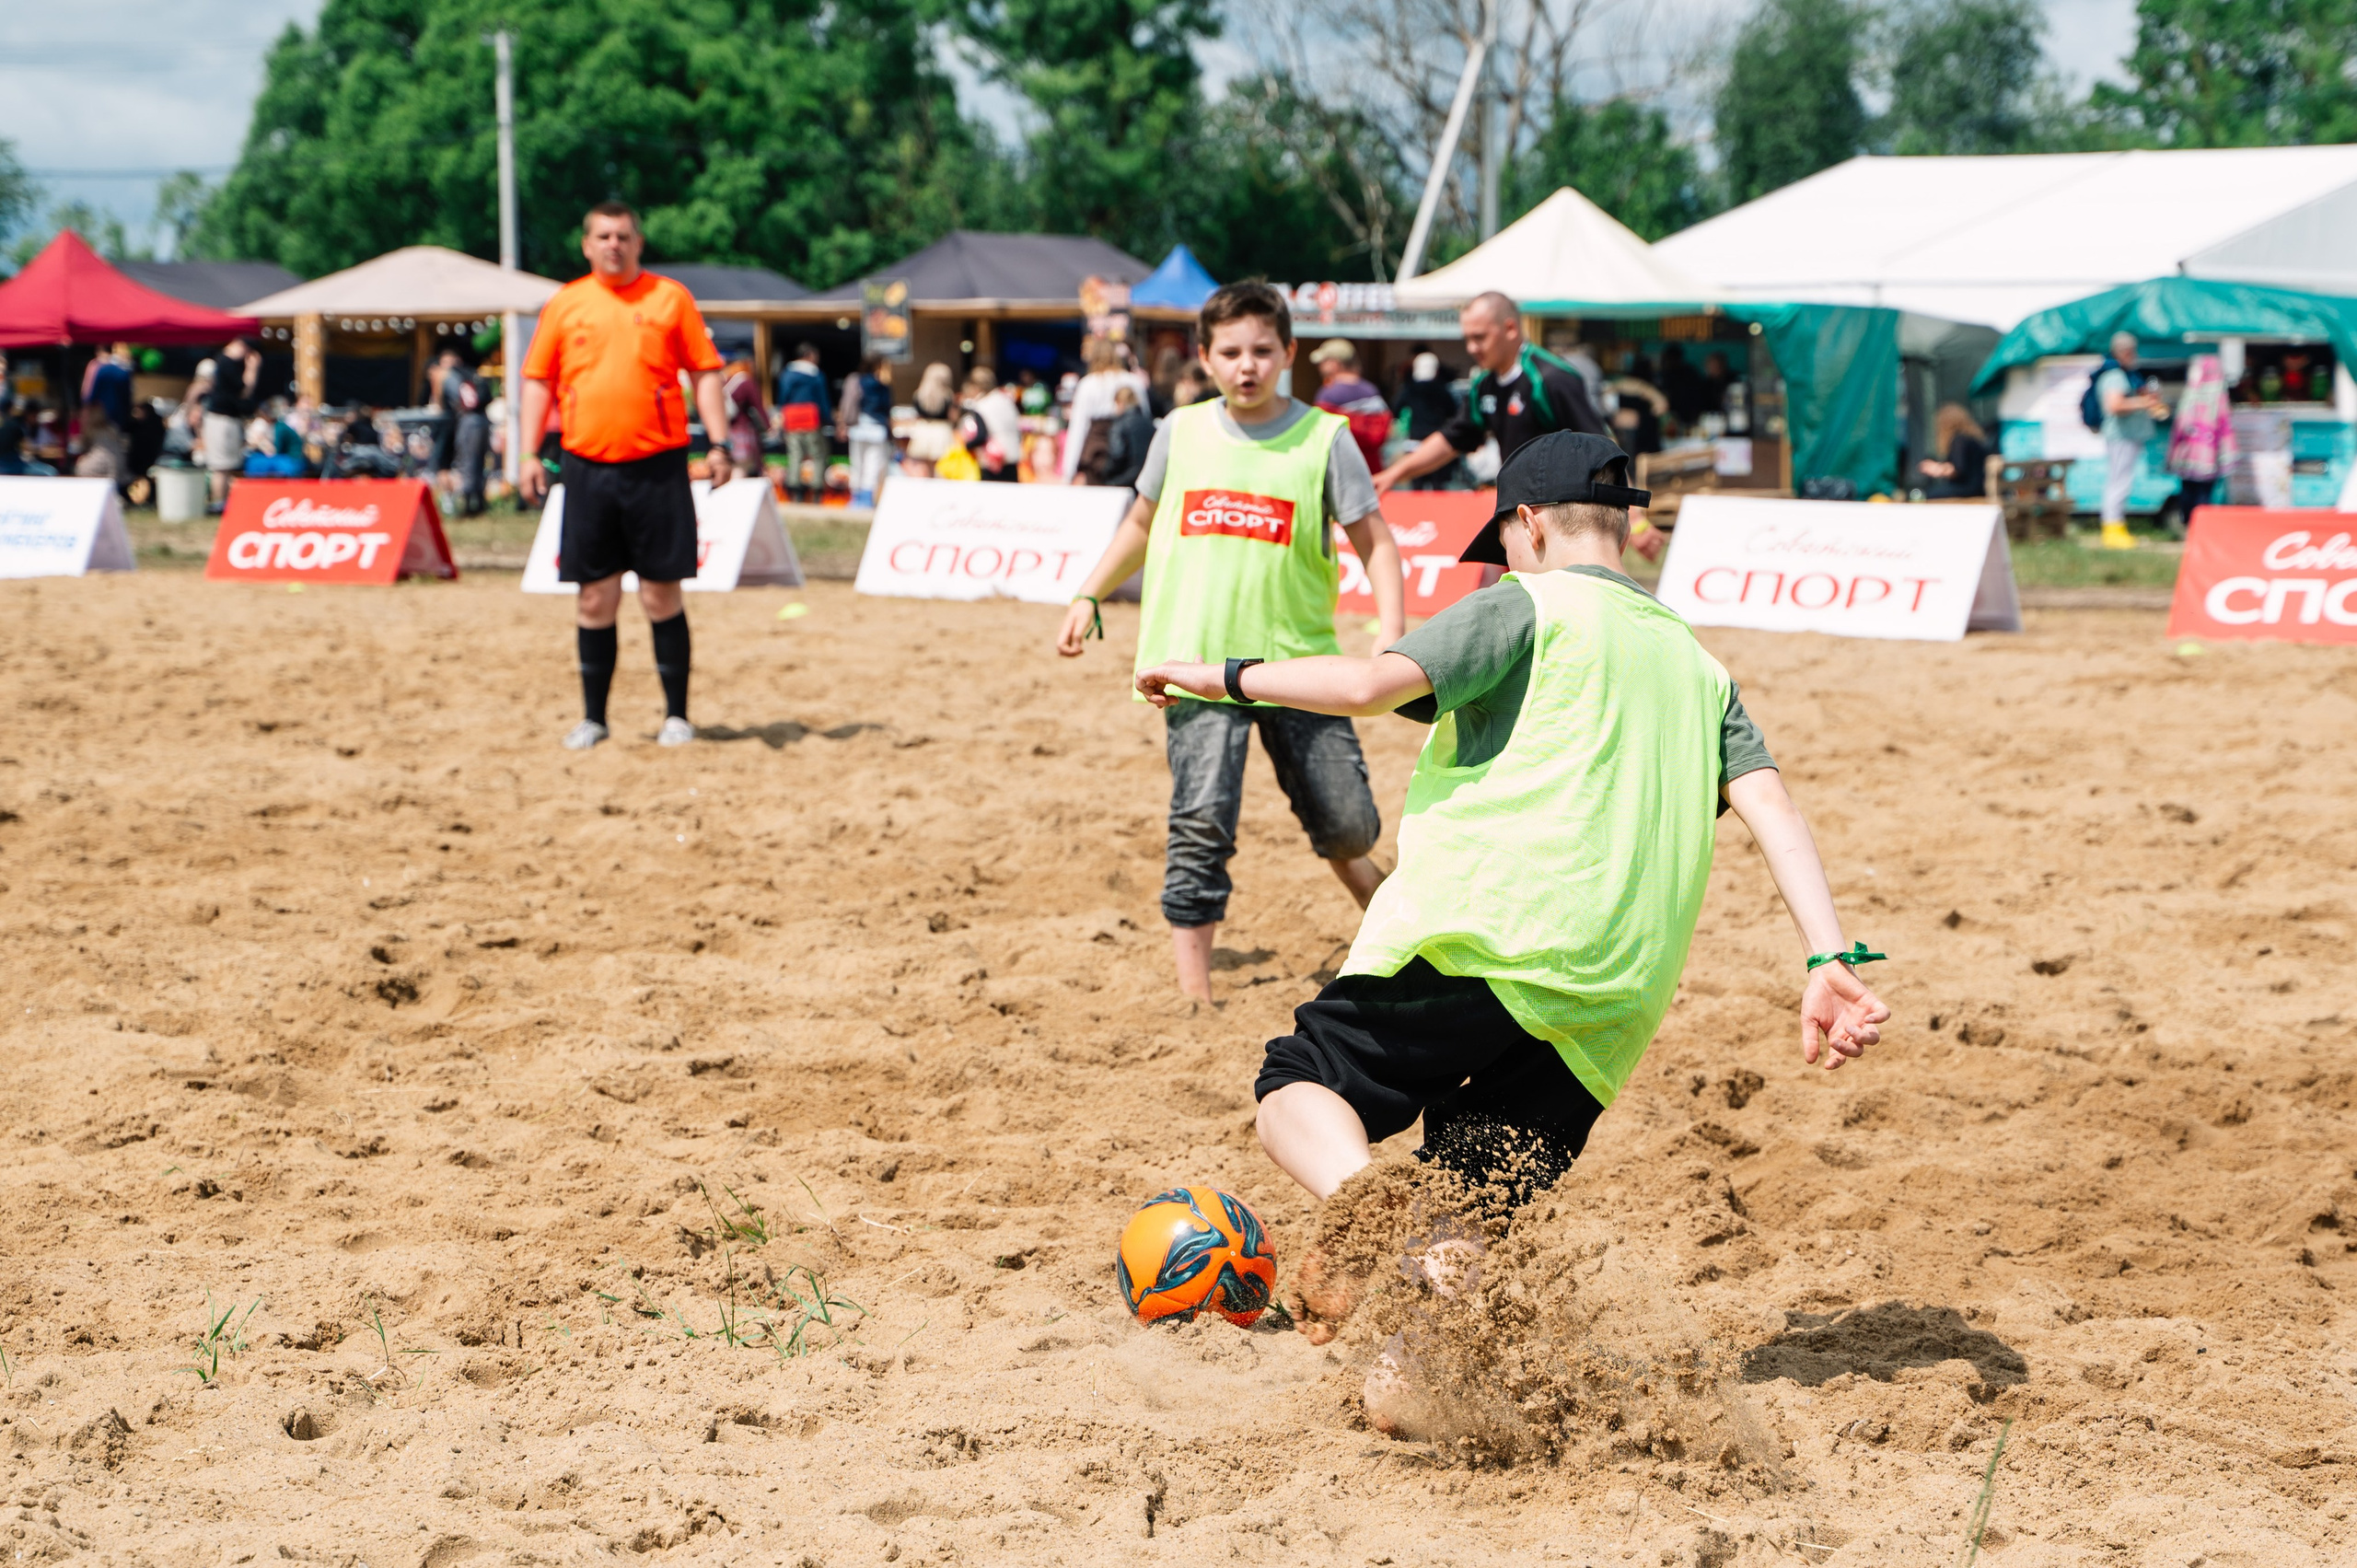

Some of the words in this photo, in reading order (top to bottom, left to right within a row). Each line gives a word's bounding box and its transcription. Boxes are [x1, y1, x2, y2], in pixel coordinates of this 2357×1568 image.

[1187, 508, 1285, 533] СПОРТ
[227, 530, 391, 569] СПОРТ
[889, 540, 1083, 582] СПОРТ
[1693, 566, 1943, 612] СПОРТ
